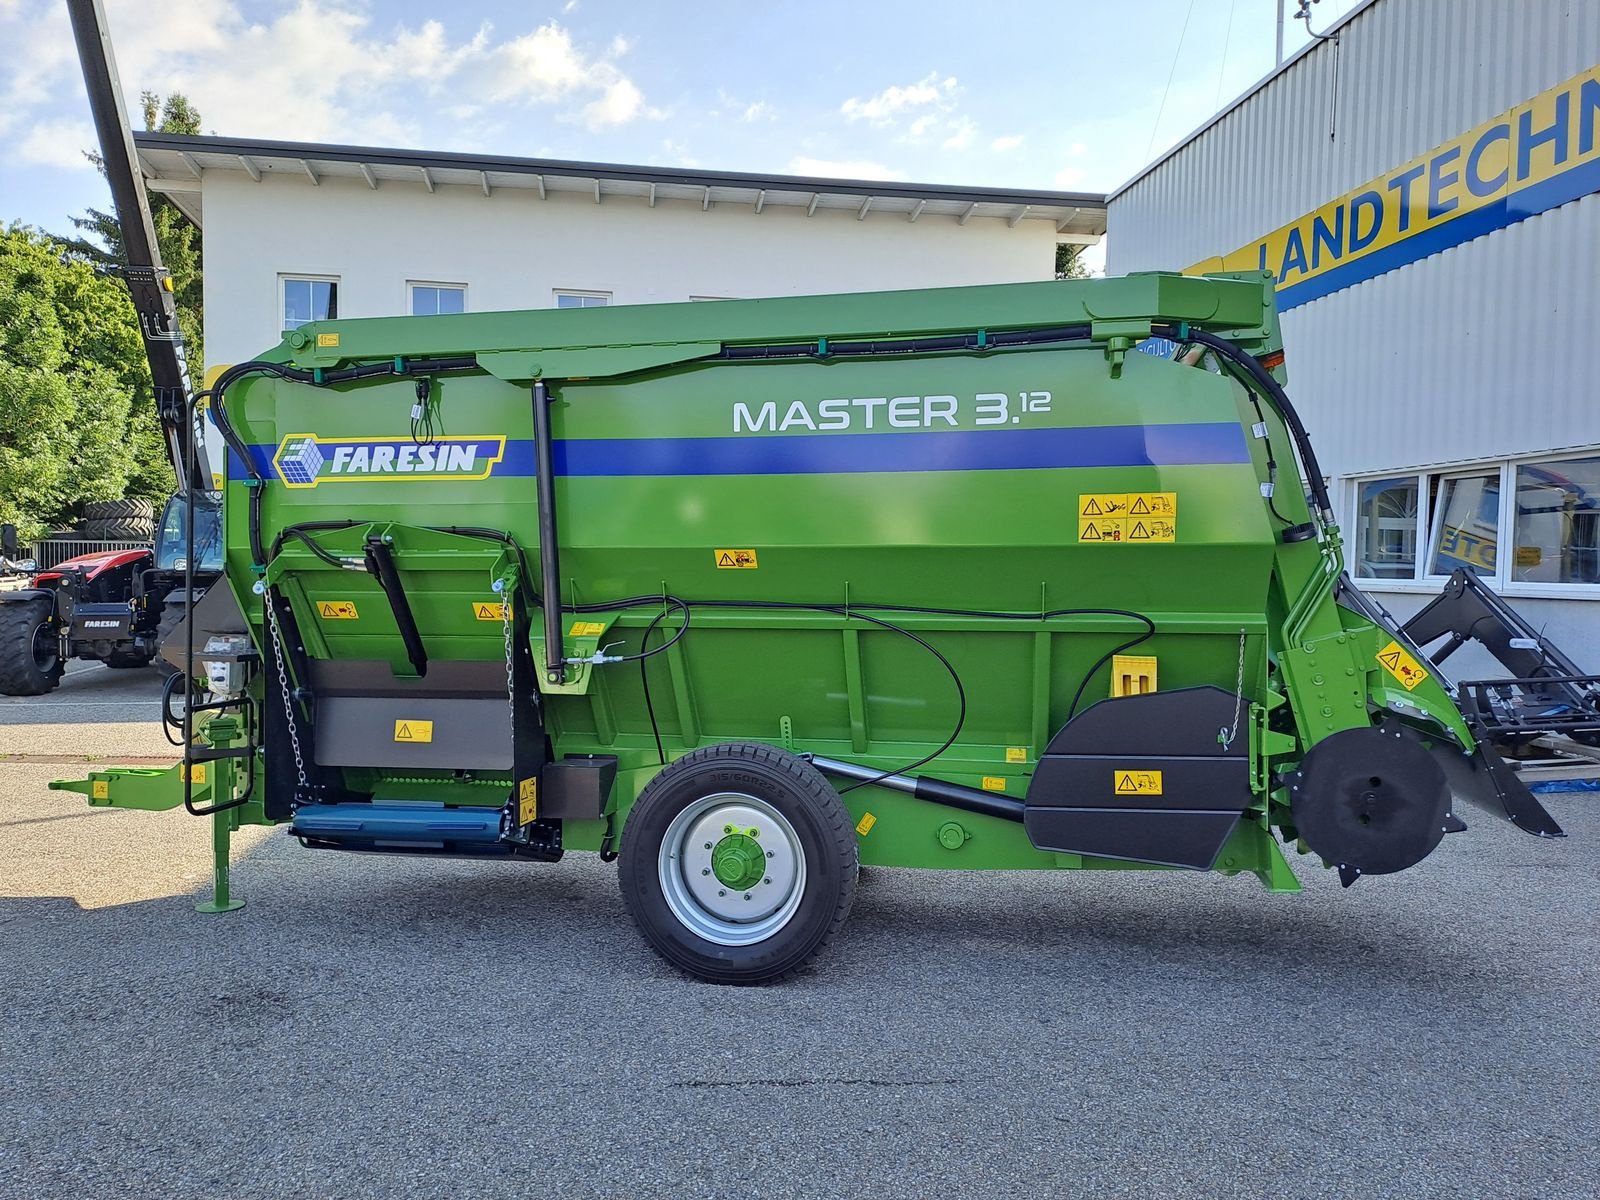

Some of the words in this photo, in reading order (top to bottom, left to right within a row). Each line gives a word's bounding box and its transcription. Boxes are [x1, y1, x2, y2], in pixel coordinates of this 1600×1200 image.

[733, 395, 959, 433] MASTER
[975, 391, 1052, 425] 3.12
[330, 444, 478, 473] FARESIN
[84, 620, 120, 628] FARESIN
